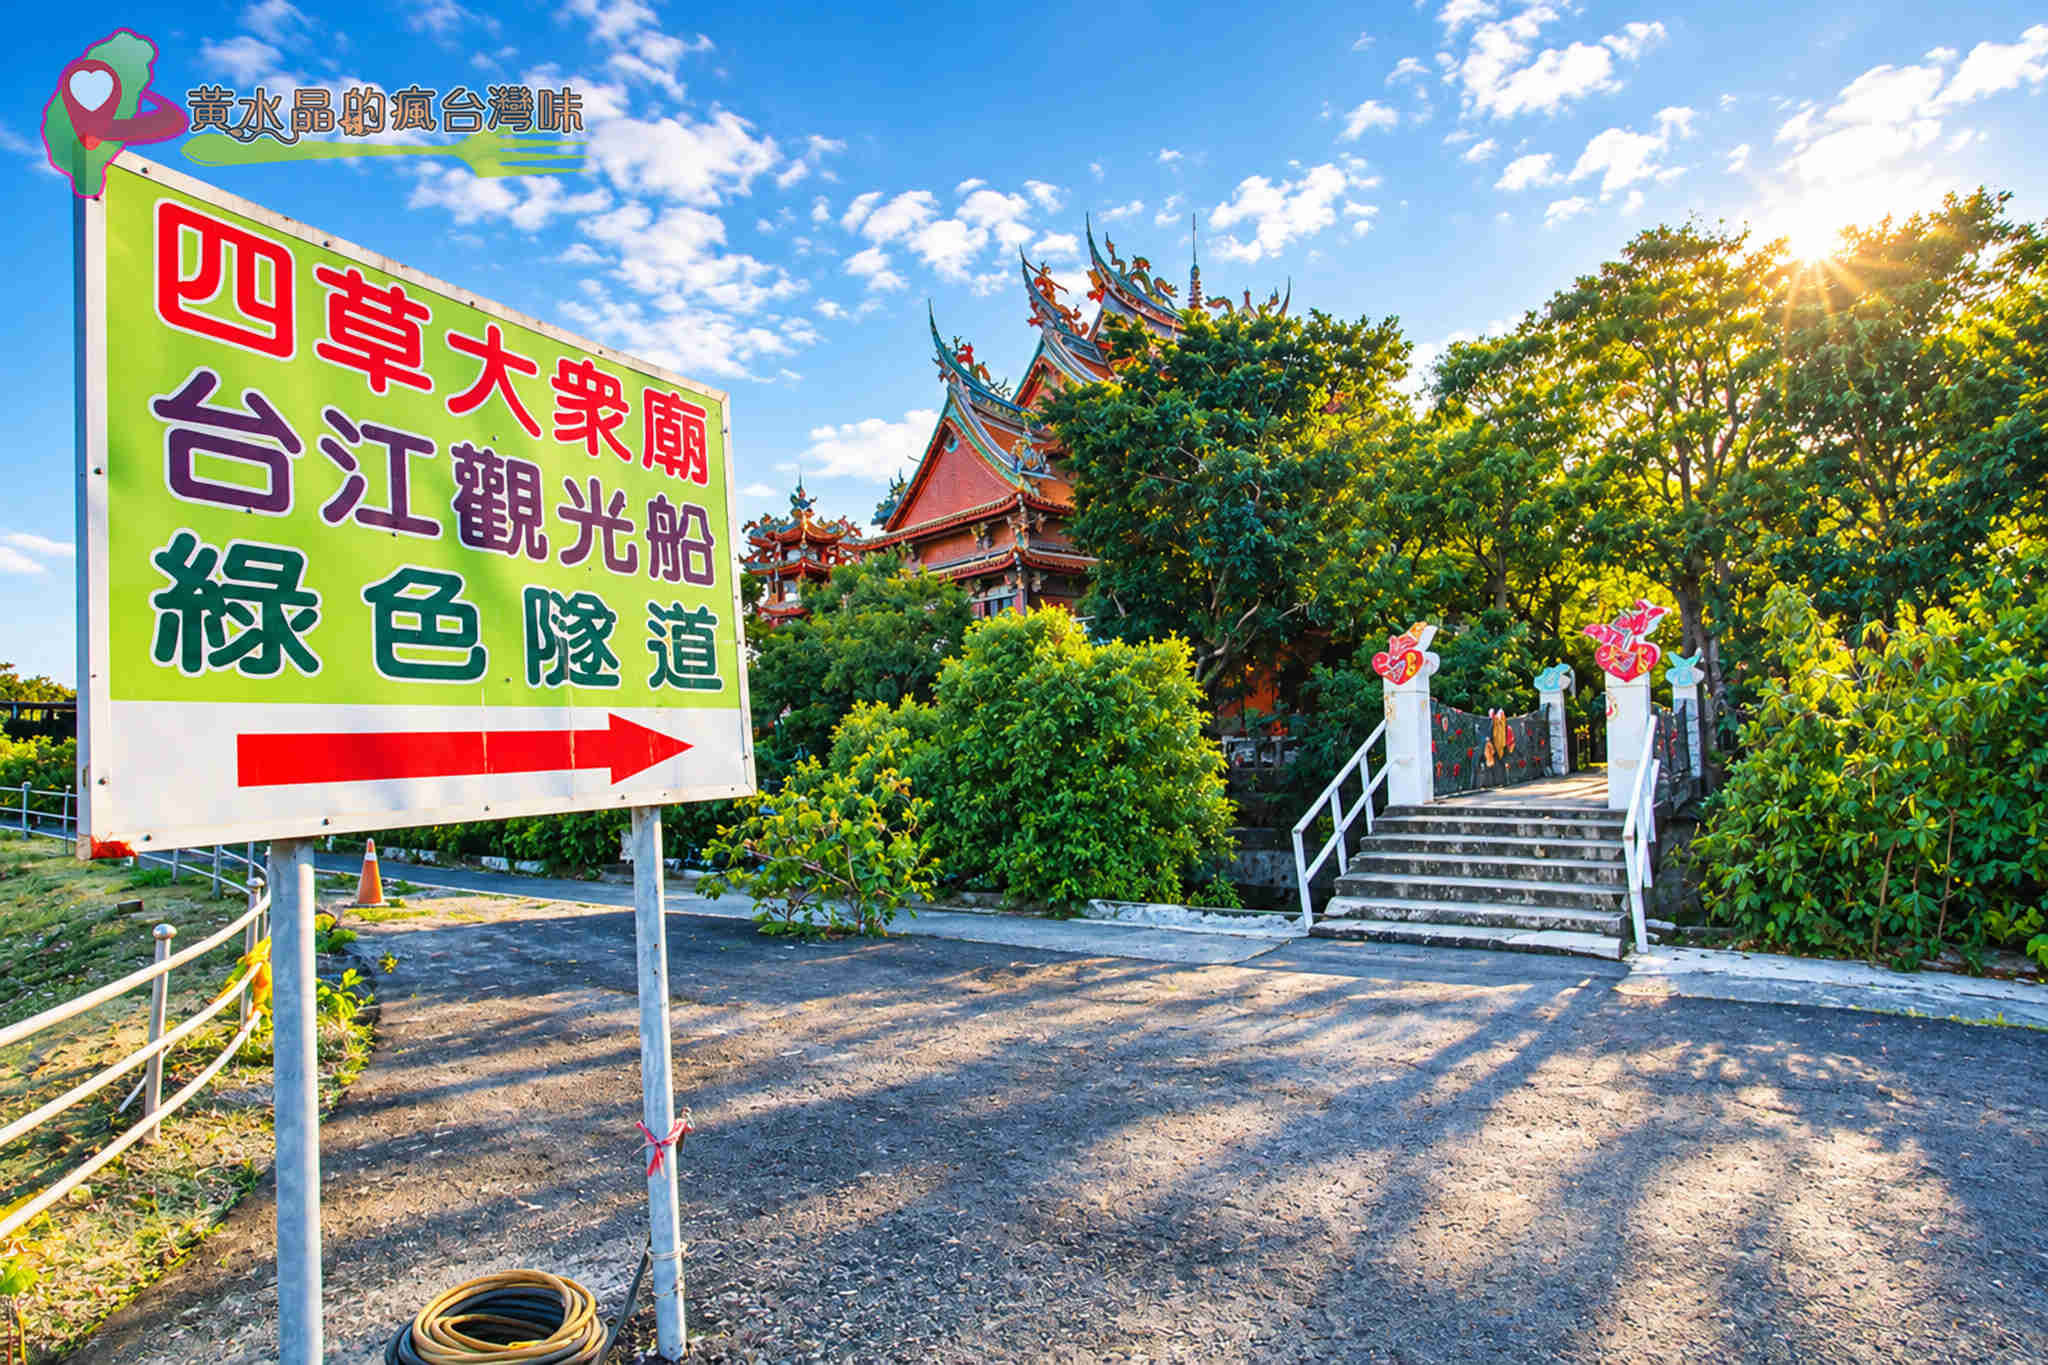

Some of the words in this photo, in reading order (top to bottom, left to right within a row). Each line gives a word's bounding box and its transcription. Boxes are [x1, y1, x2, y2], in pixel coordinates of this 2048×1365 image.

[153, 371, 714, 586] 台江觀光船
[153, 532, 722, 690] 綠色隧道
